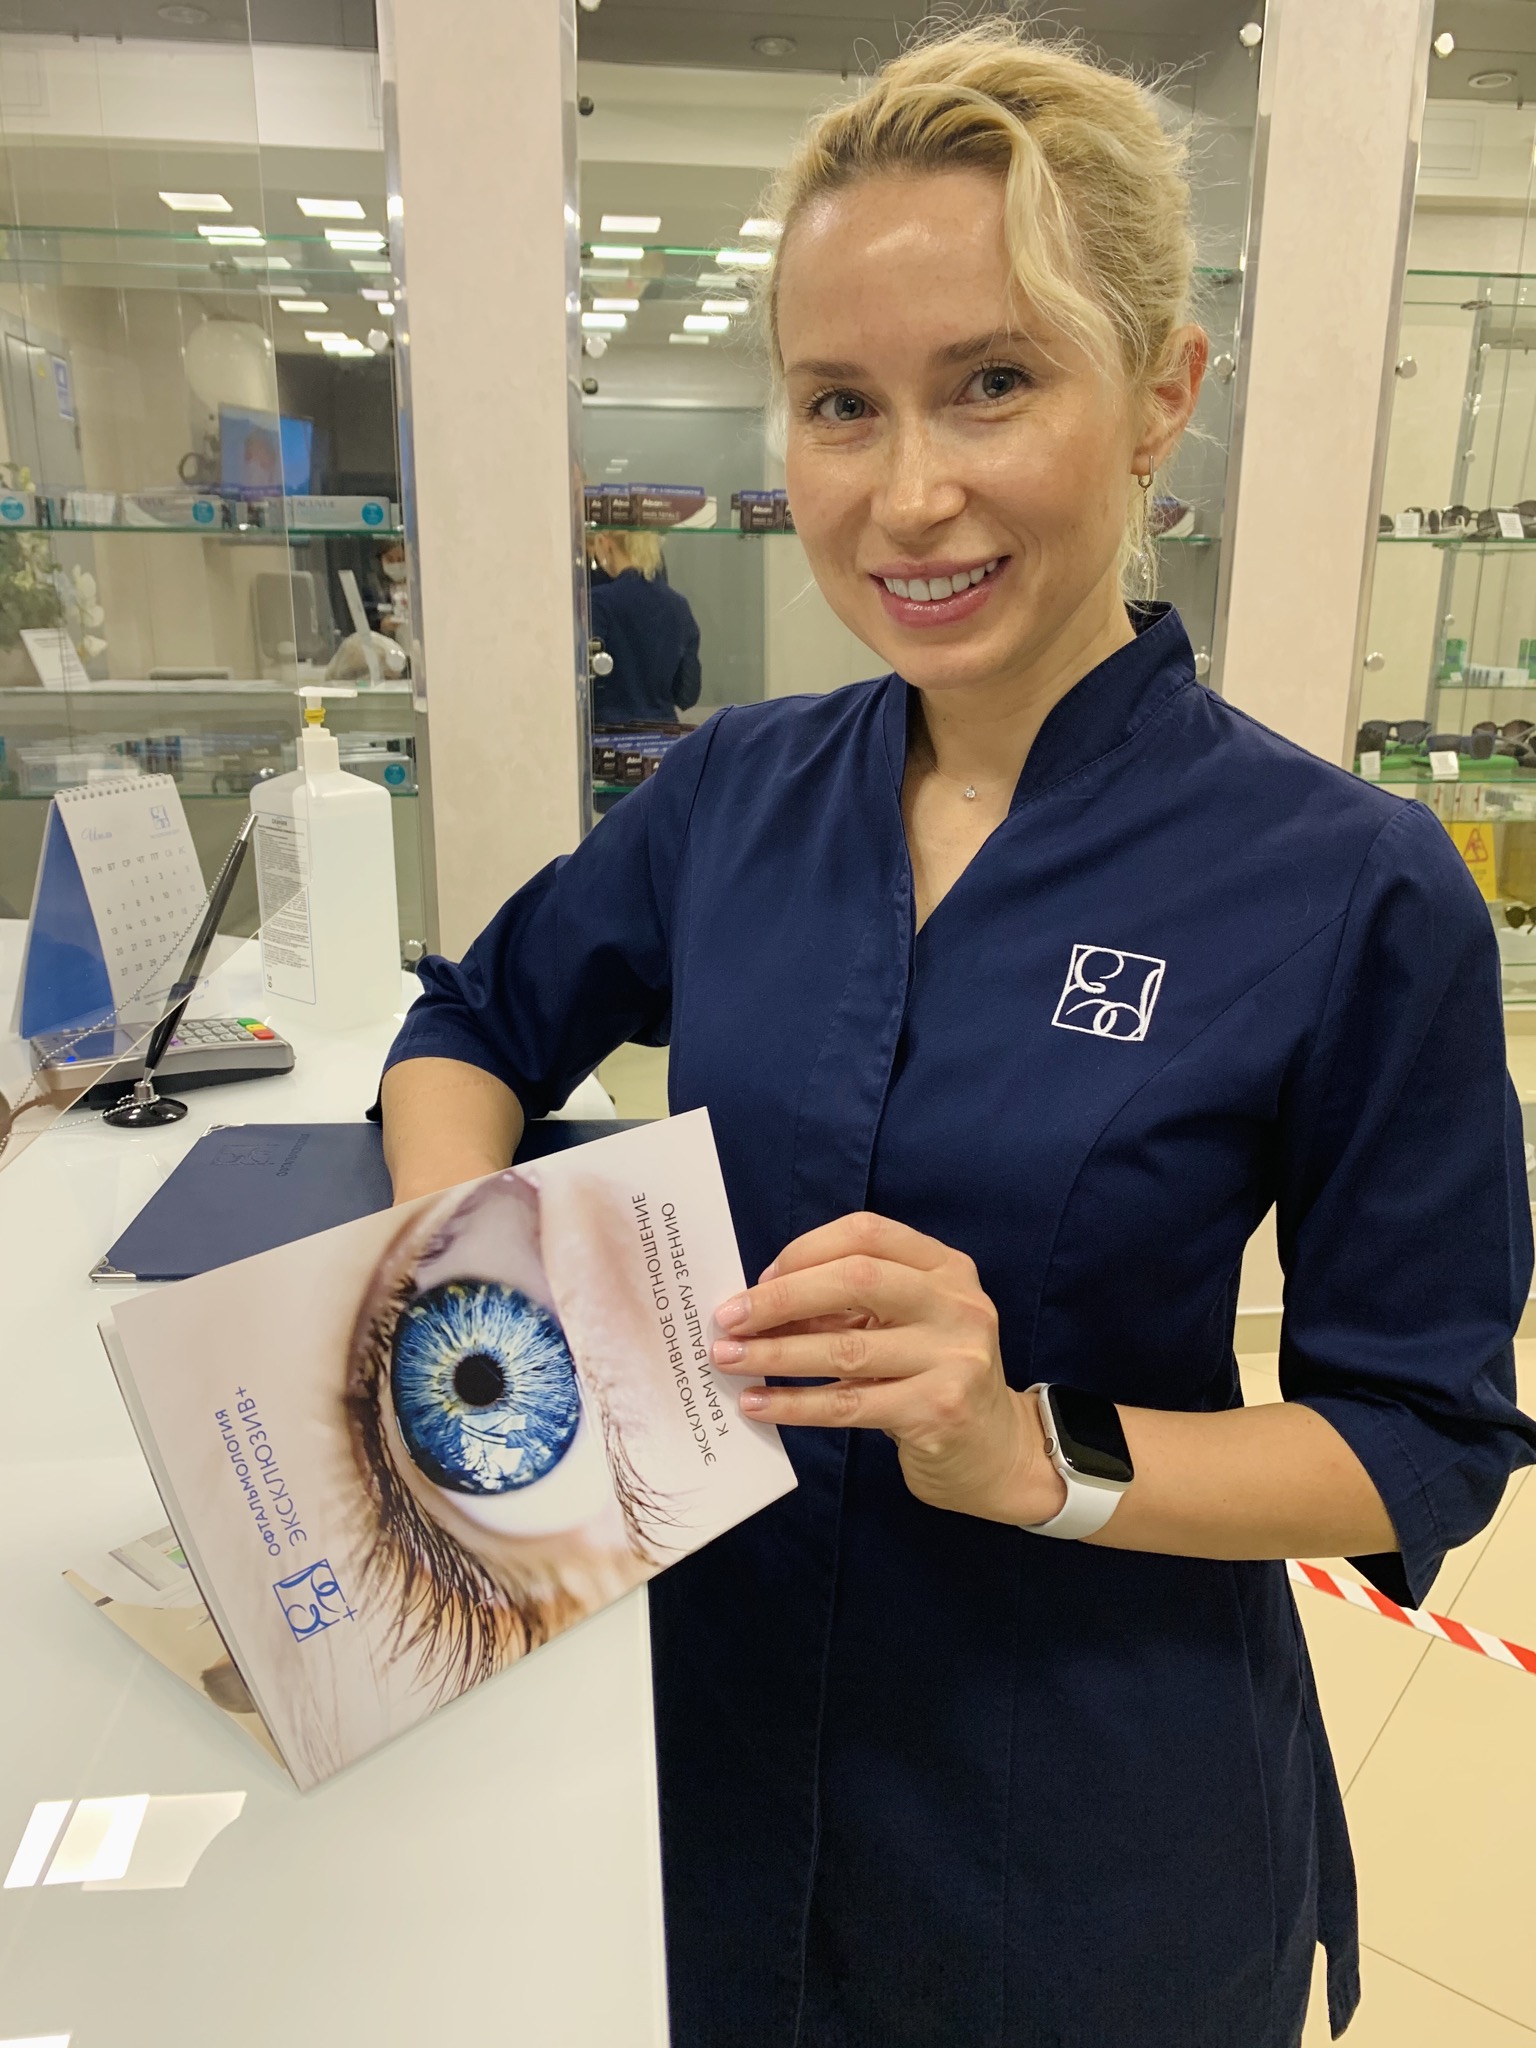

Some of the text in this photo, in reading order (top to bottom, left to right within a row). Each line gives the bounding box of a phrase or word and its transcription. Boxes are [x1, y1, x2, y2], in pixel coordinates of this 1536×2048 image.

[632, 1192, 717, 1466] ЭКСКЛЮЗИВНОЕ ОТНОШЕНИЕ
[661, 1202, 729, 1436] К ВАМ И ВАШЕМУ ЗРЕНИЮ
[215, 1409, 281, 1556] ОФТАЛЬМОЛОГИЯ
[235, 1386, 307, 1547] ЭКСКЛЮЗИВ+
